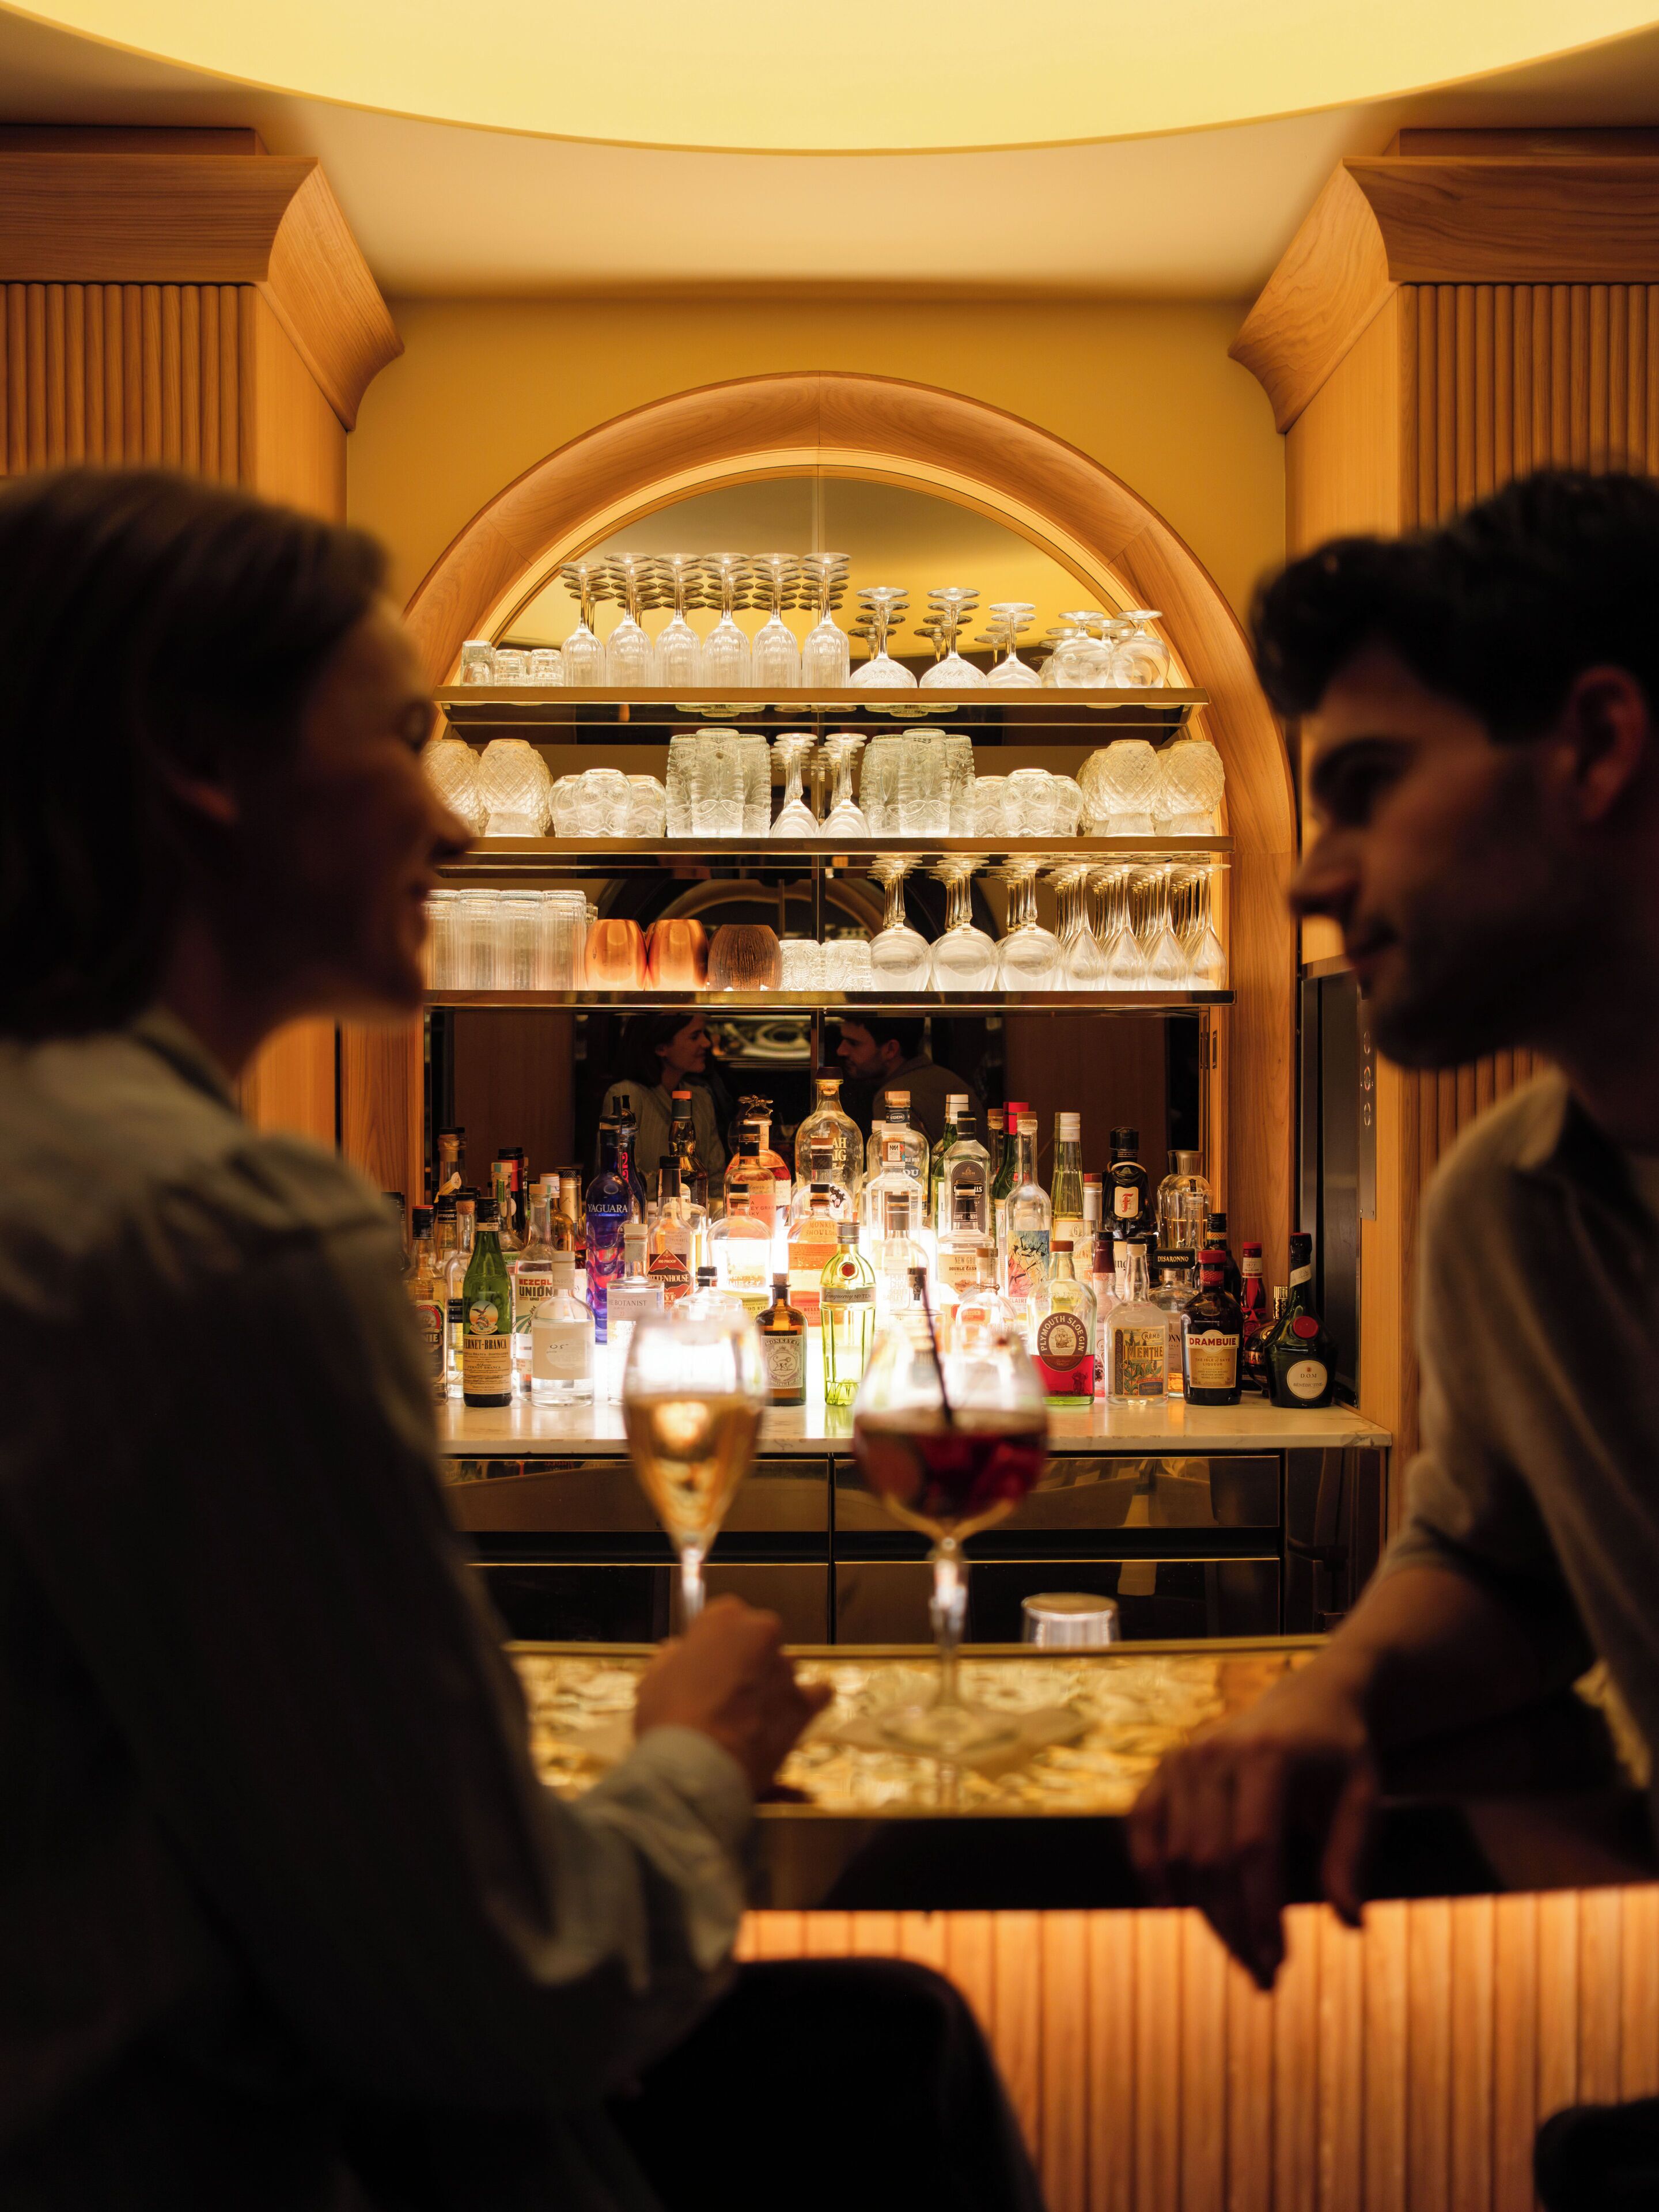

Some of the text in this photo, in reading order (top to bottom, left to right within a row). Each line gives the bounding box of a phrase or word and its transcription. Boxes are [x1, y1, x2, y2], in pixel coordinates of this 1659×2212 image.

[587, 1203, 628, 1213] YAGUARA
[955, 1256, 976, 1264] NEW GRO
[825, 1291, 853, 1300] Tanqueray
[1040, 1315, 1065, 1351] PLYMOUTH
[1067, 1317, 1084, 1335] SLOE
[463, 1338, 507, 1350] FERNET-BRANCA
[765, 1338, 793, 1346] MONKEY
[1190, 1337, 1237, 1346] DRAMBUIE
[1124, 1343, 1163, 1359] MENTHE
